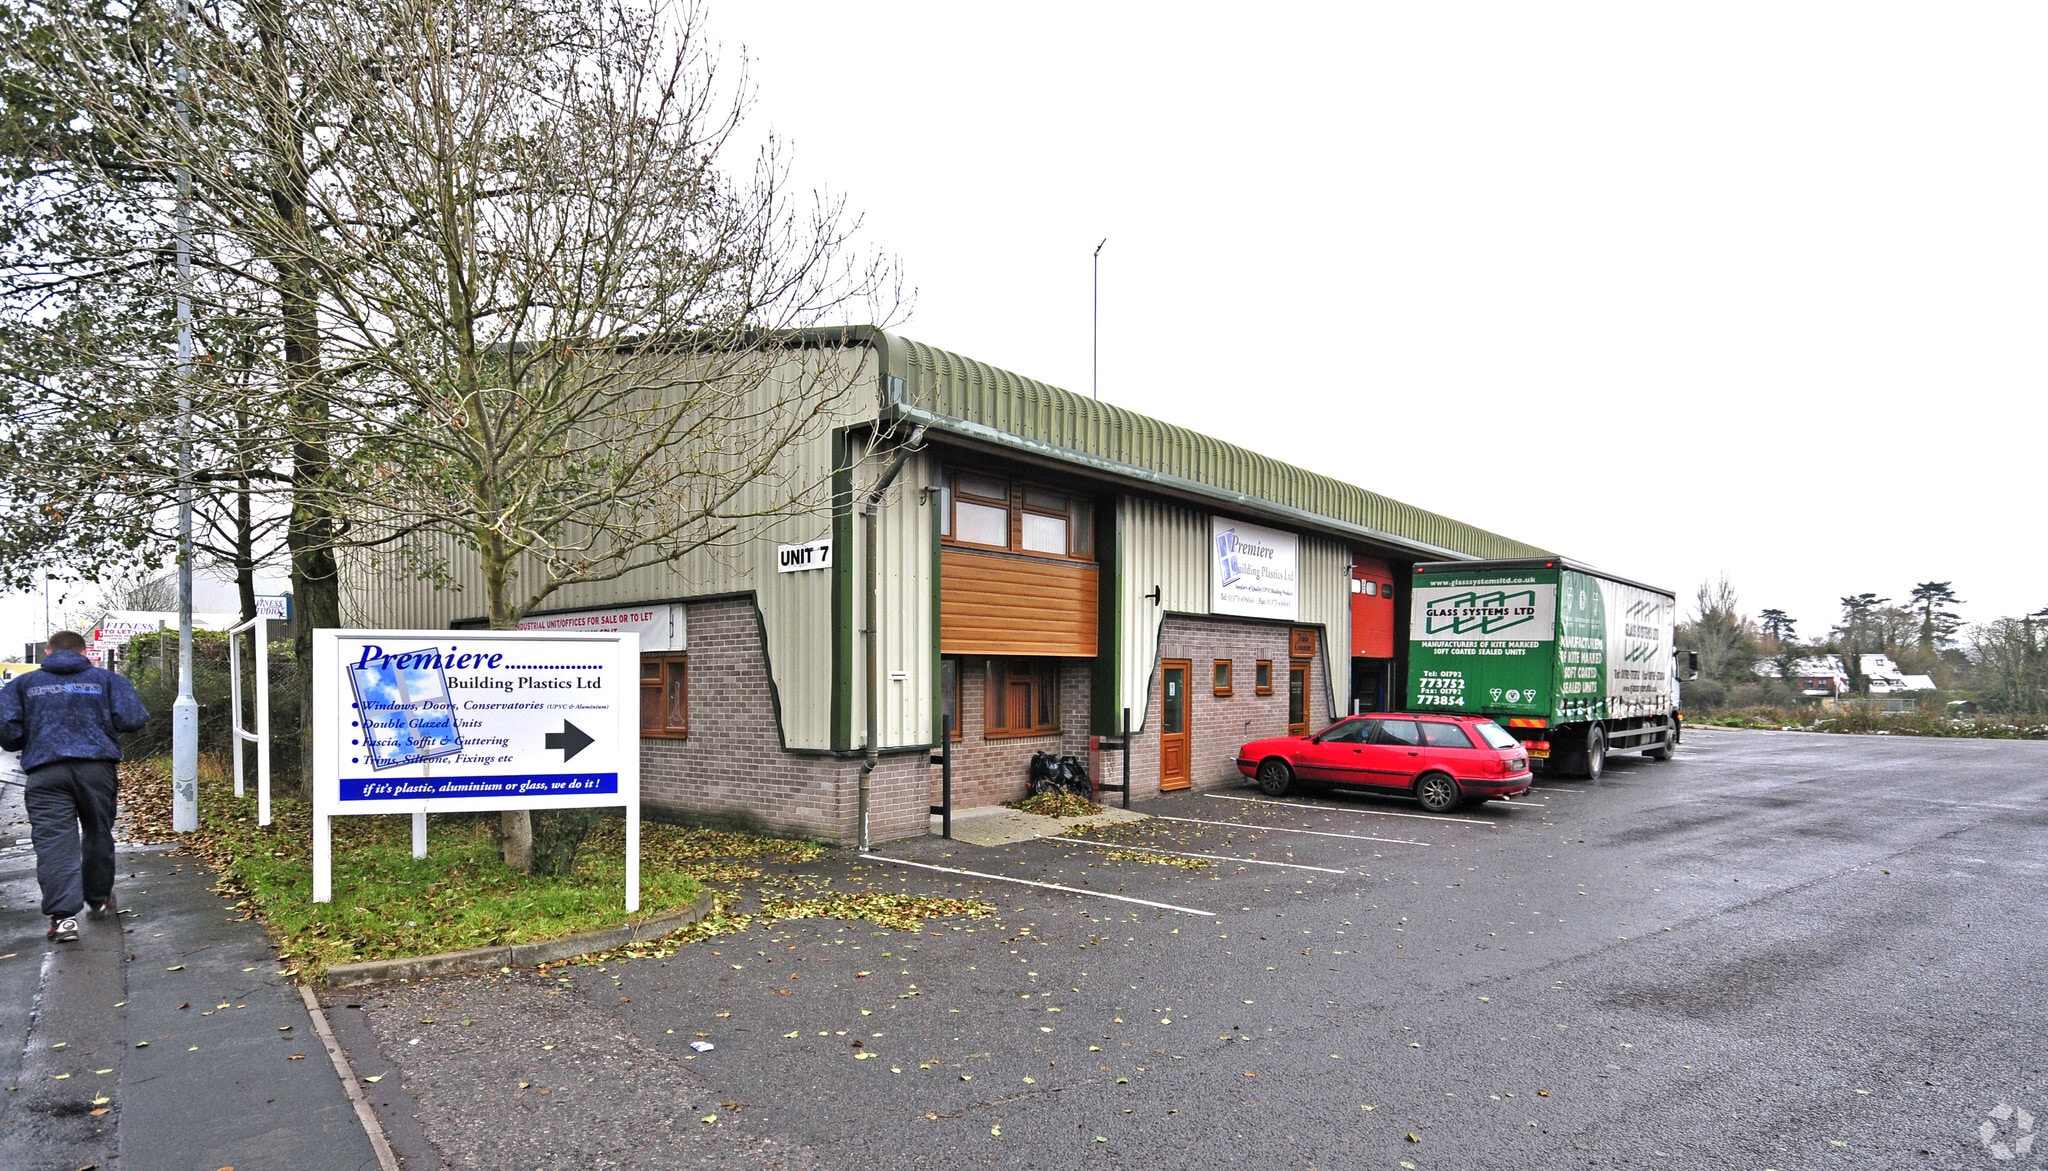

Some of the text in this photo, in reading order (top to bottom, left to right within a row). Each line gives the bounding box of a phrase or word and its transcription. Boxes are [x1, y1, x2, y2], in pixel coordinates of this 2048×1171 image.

[1231, 535, 1274, 559] Premiere
[781, 546, 829, 566] UNIT 7
[1262, 566, 1283, 580] Plastics
[1284, 570, 1294, 581] Ltd
[1430, 577, 1536, 586] www.glasssystemsltd.co.uk
[256, 600, 284, 609] ITNESS
[256, 607, 281, 615] TUDIO
[1426, 607, 1535, 617] GLASS SYSTEMS LTD
[106, 622, 154, 630] FITNESS
[516, 611, 653, 630] NDUSTRIAL UNIT/OFFICES FOR SALE OR TO LET
[354, 645, 504, 670] Premiere
[447, 676, 602, 693] Building Plastics Ltd
[1420, 678, 1465, 689] 773752
[362, 700, 419, 711] Windows,
[423, 700, 459, 711] Doors,
[463, 700, 544, 710] Conservatories
[1417, 694, 1465, 706] 773854
[362, 718, 482, 729] Double Glazed Units
[362, 736, 510, 749] Fascia, Soffit & Guttering
[363, 754, 513, 766] Trims, Silicone, Fixings etc
[363, 783, 376, 797] if
[393, 782, 436, 797] plastic,
[438, 781, 502, 793] aluminium
[505, 782, 518, 790] or
[519, 779, 548, 793] glass,
[551, 781, 566, 789] we
[568, 778, 582, 789] do
[584, 779, 594, 788] it
